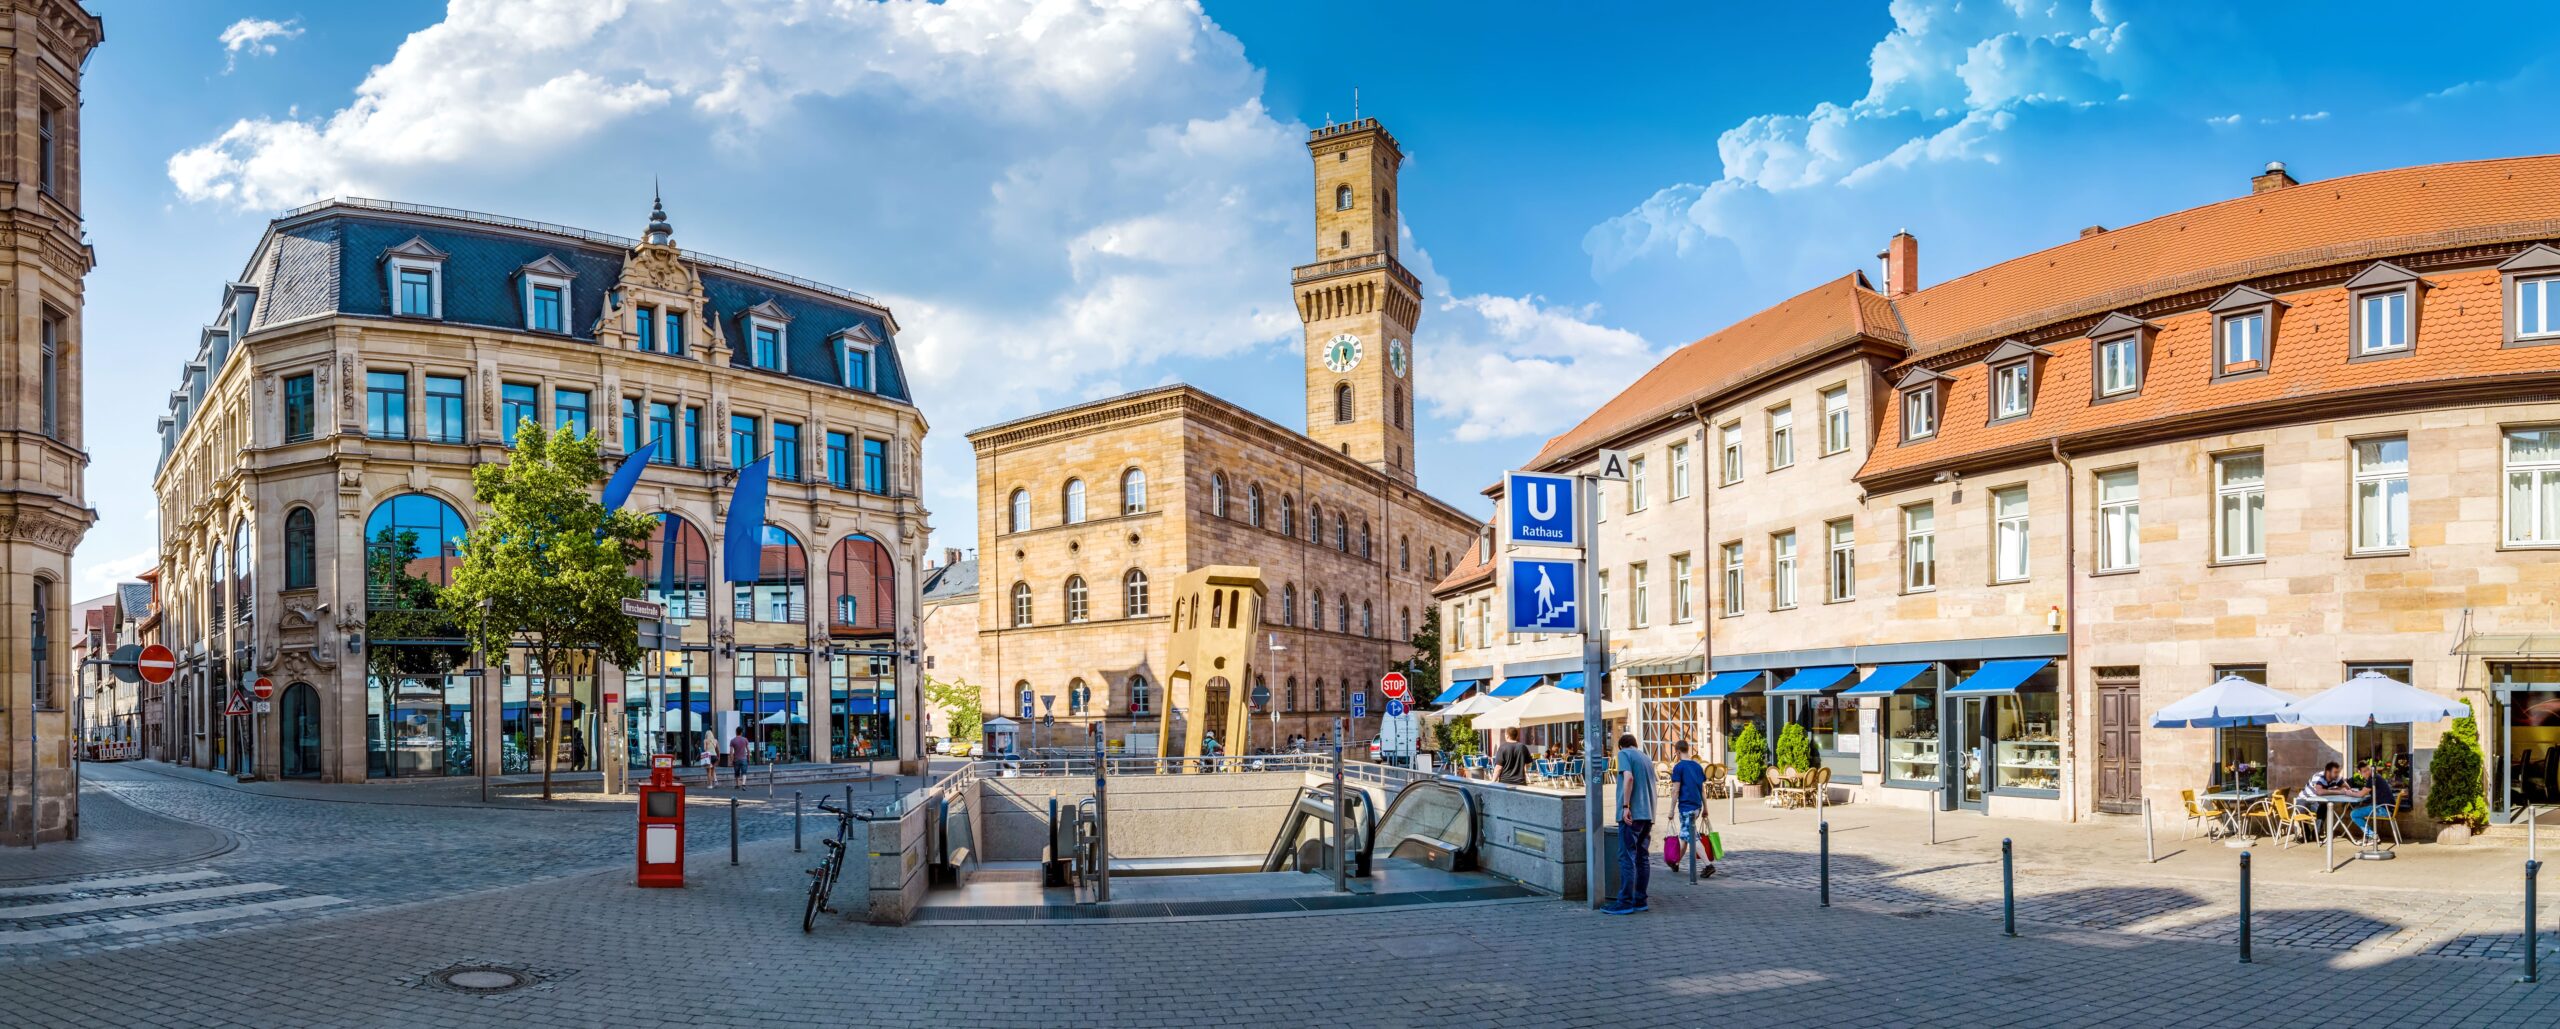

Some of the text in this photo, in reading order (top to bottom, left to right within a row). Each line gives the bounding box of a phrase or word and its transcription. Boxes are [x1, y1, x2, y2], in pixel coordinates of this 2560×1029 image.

[1604, 454, 1625, 478] A
[1527, 482, 1557, 521] U
[1522, 525, 1564, 538] Rathaus
[1383, 680, 1405, 691] STOP
